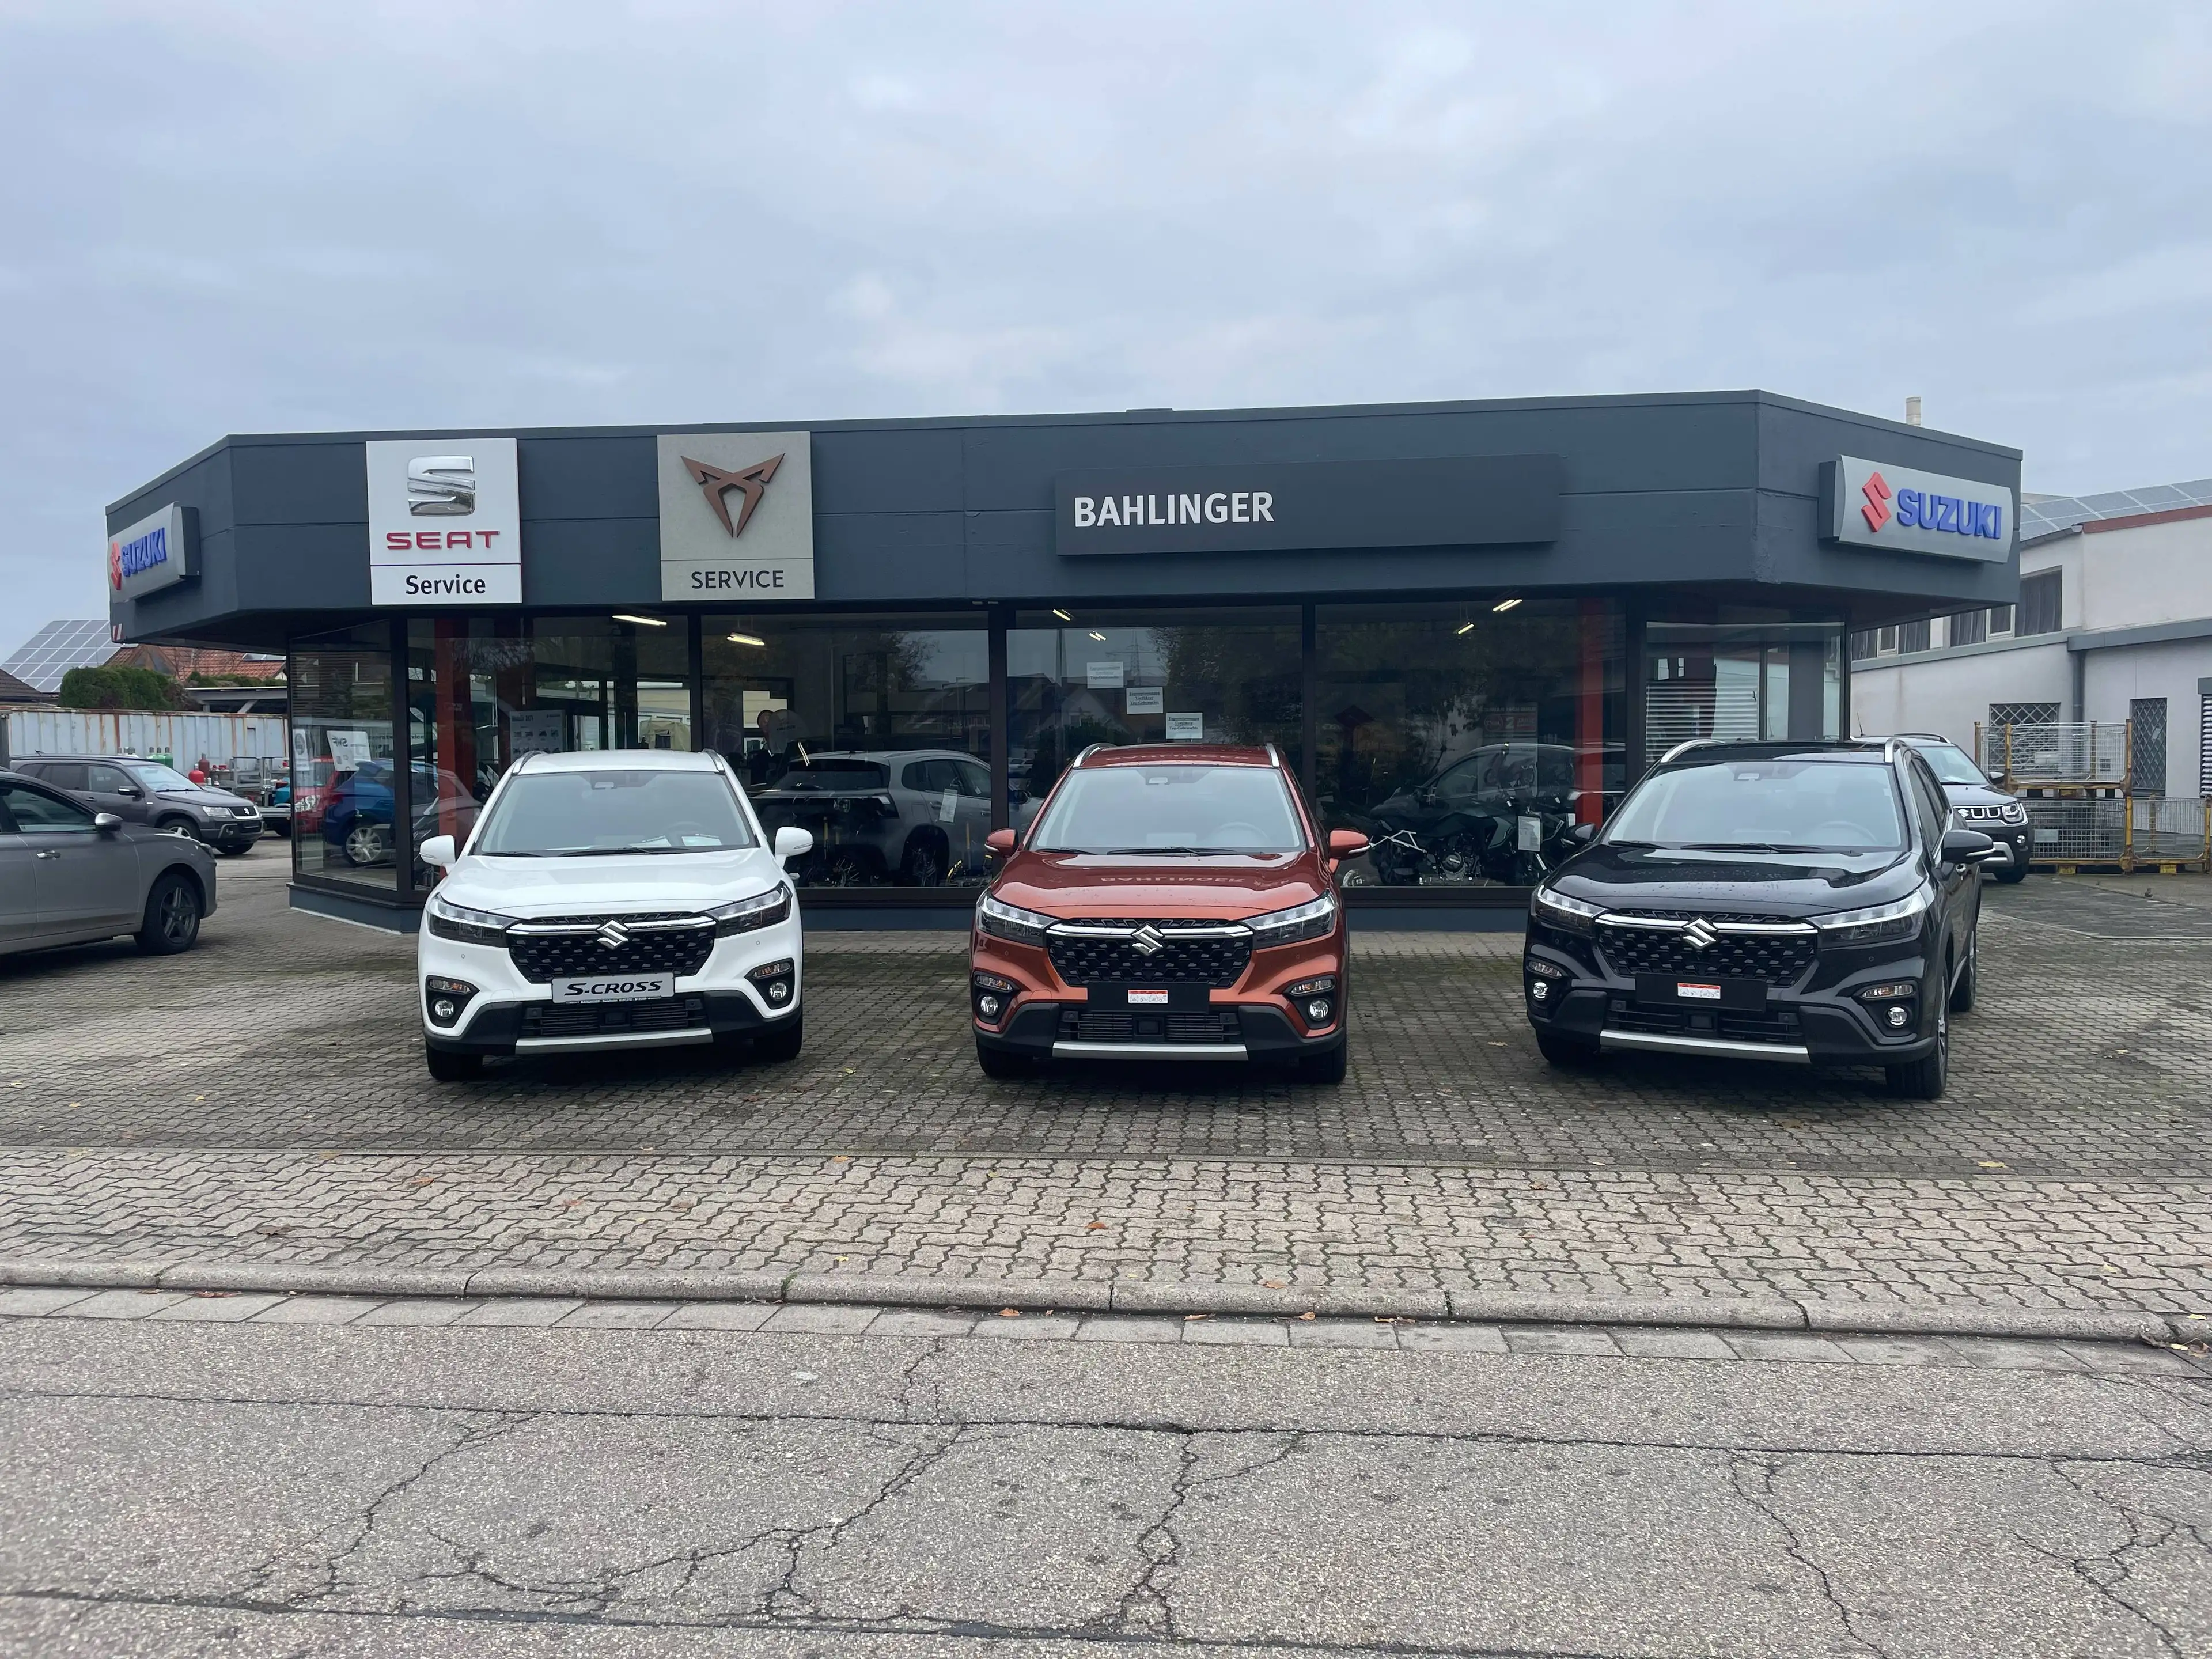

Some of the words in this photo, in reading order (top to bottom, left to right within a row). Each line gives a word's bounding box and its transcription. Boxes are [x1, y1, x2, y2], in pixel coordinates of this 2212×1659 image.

[1074, 491, 1275, 527] BAHLINGER
[1897, 488, 2002, 539] SUZUKI
[387, 531, 500, 550] SEAT
[122, 527, 167, 578] SUZUKI
[406, 574, 486, 594] Service
[691, 570, 784, 589] SERVICE
[564, 981, 662, 995] S-CROSS
